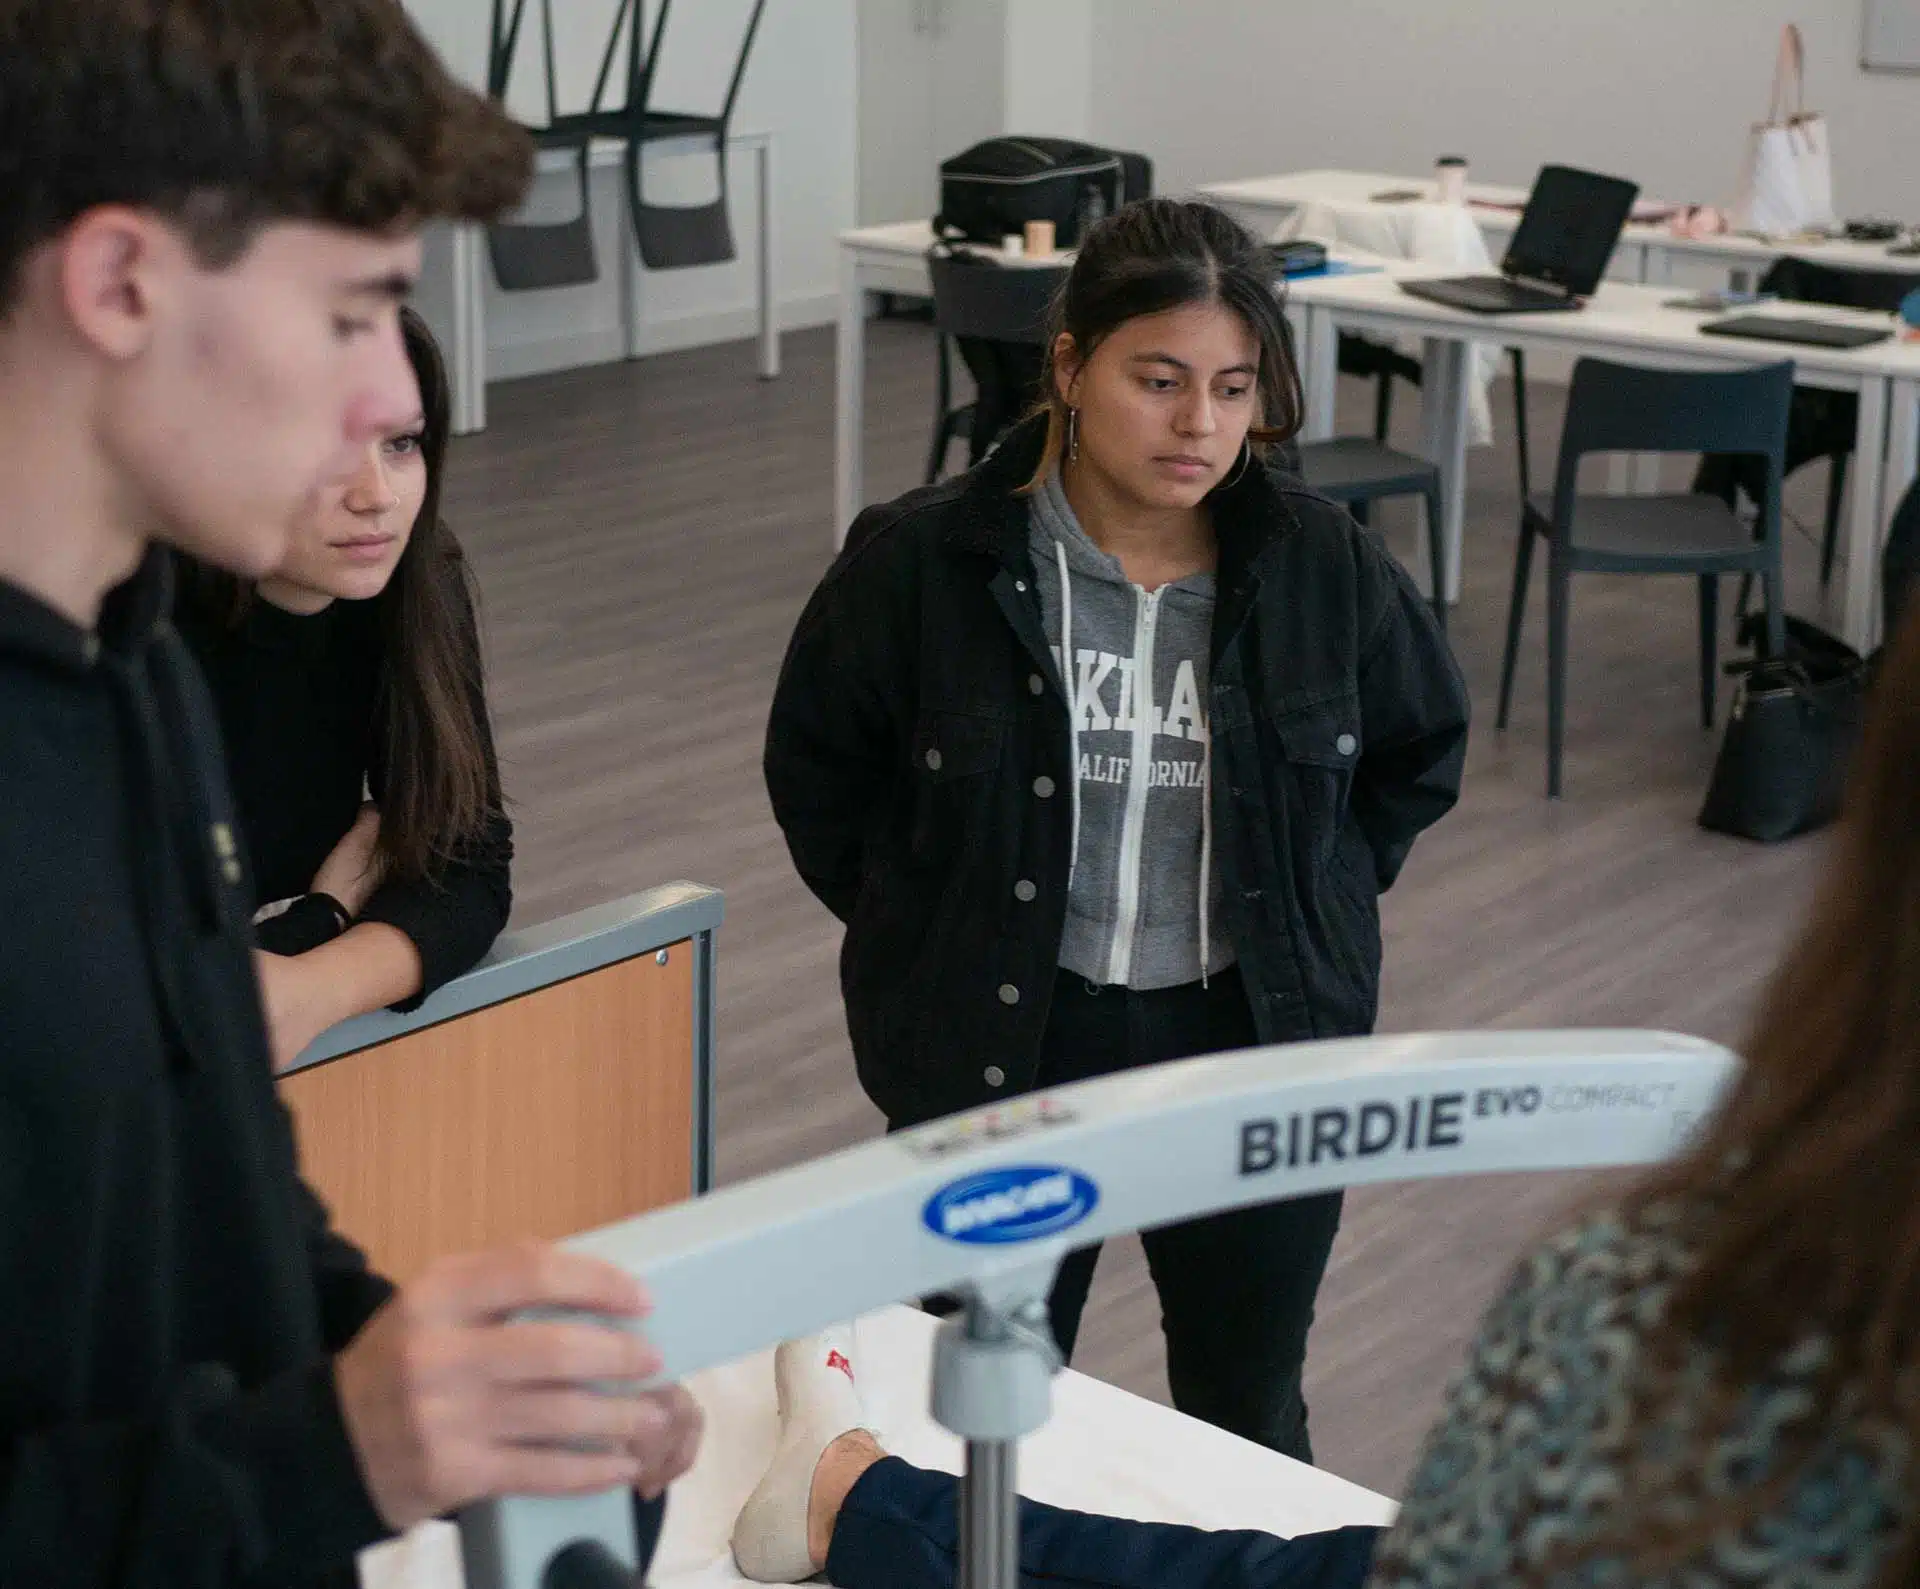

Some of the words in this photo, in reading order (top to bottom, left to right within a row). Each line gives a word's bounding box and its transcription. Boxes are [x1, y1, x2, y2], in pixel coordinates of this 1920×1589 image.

[1050, 646, 1209, 743] KLA
[1239, 1090, 1466, 1177] BIRDIE
[1473, 1085, 1542, 1119] EVO
